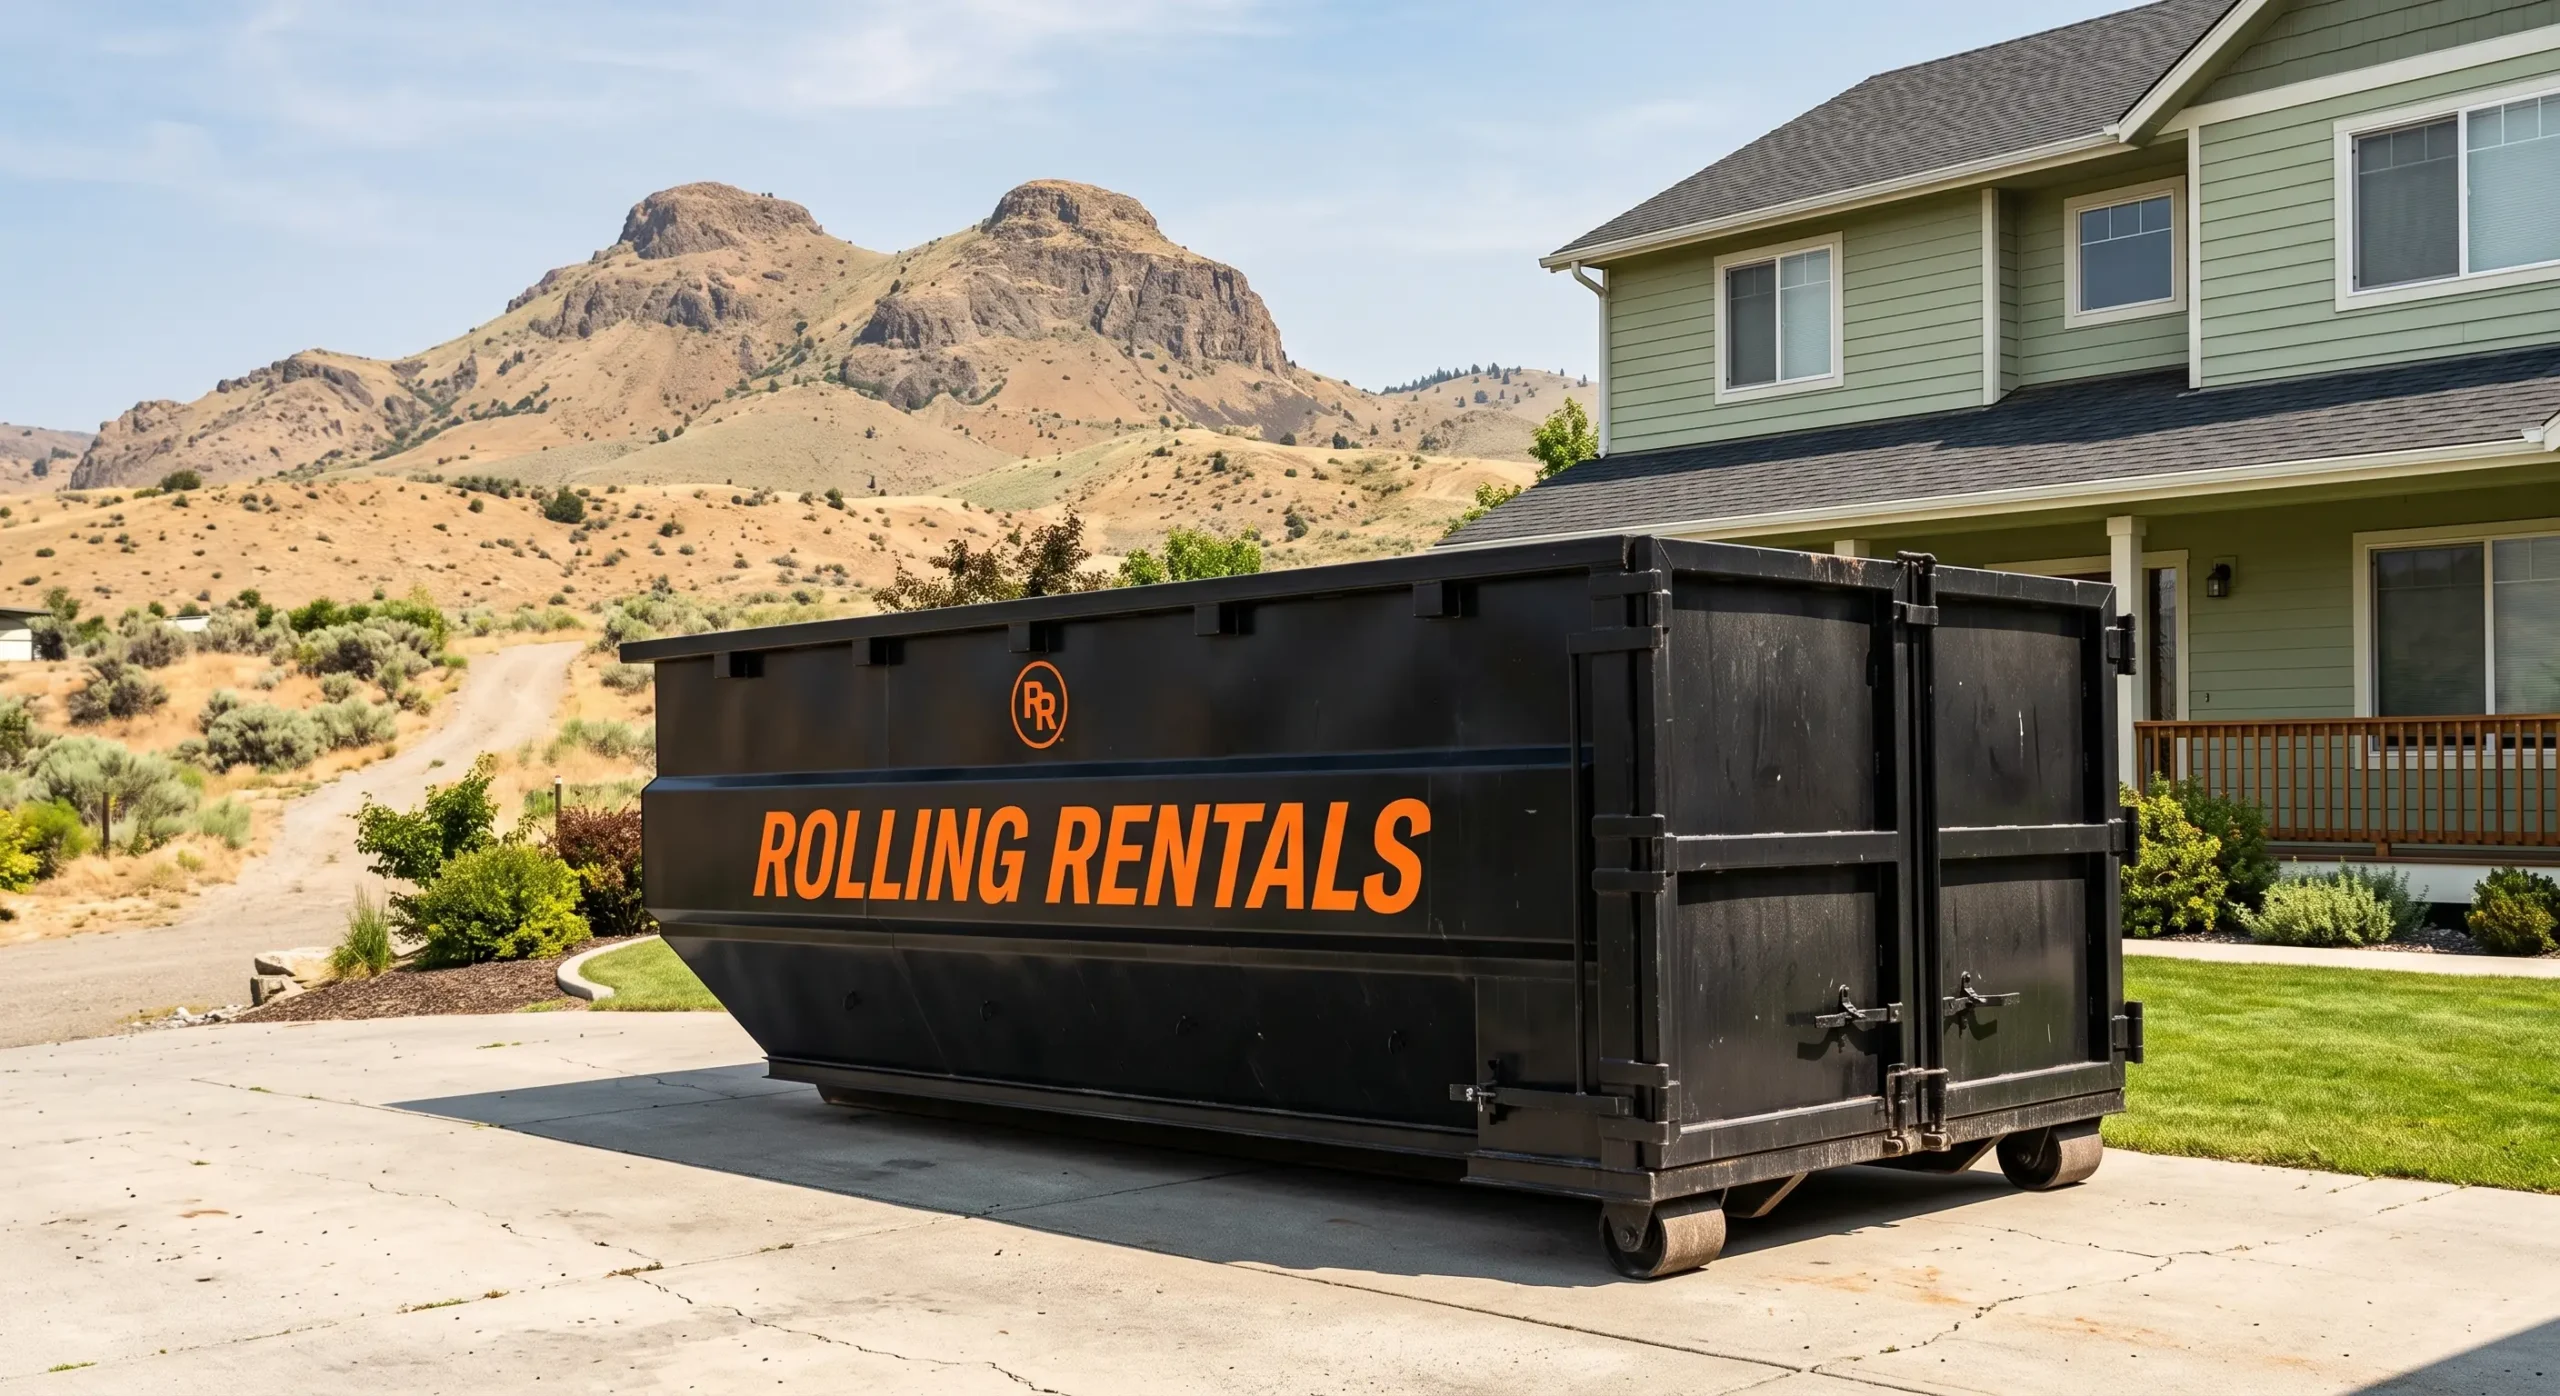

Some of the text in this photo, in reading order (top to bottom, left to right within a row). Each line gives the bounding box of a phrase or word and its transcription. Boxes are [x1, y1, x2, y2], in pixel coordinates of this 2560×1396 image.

[1023, 681, 1057, 731] RR
[754, 799, 1431, 914] ROLLING RENTALS
